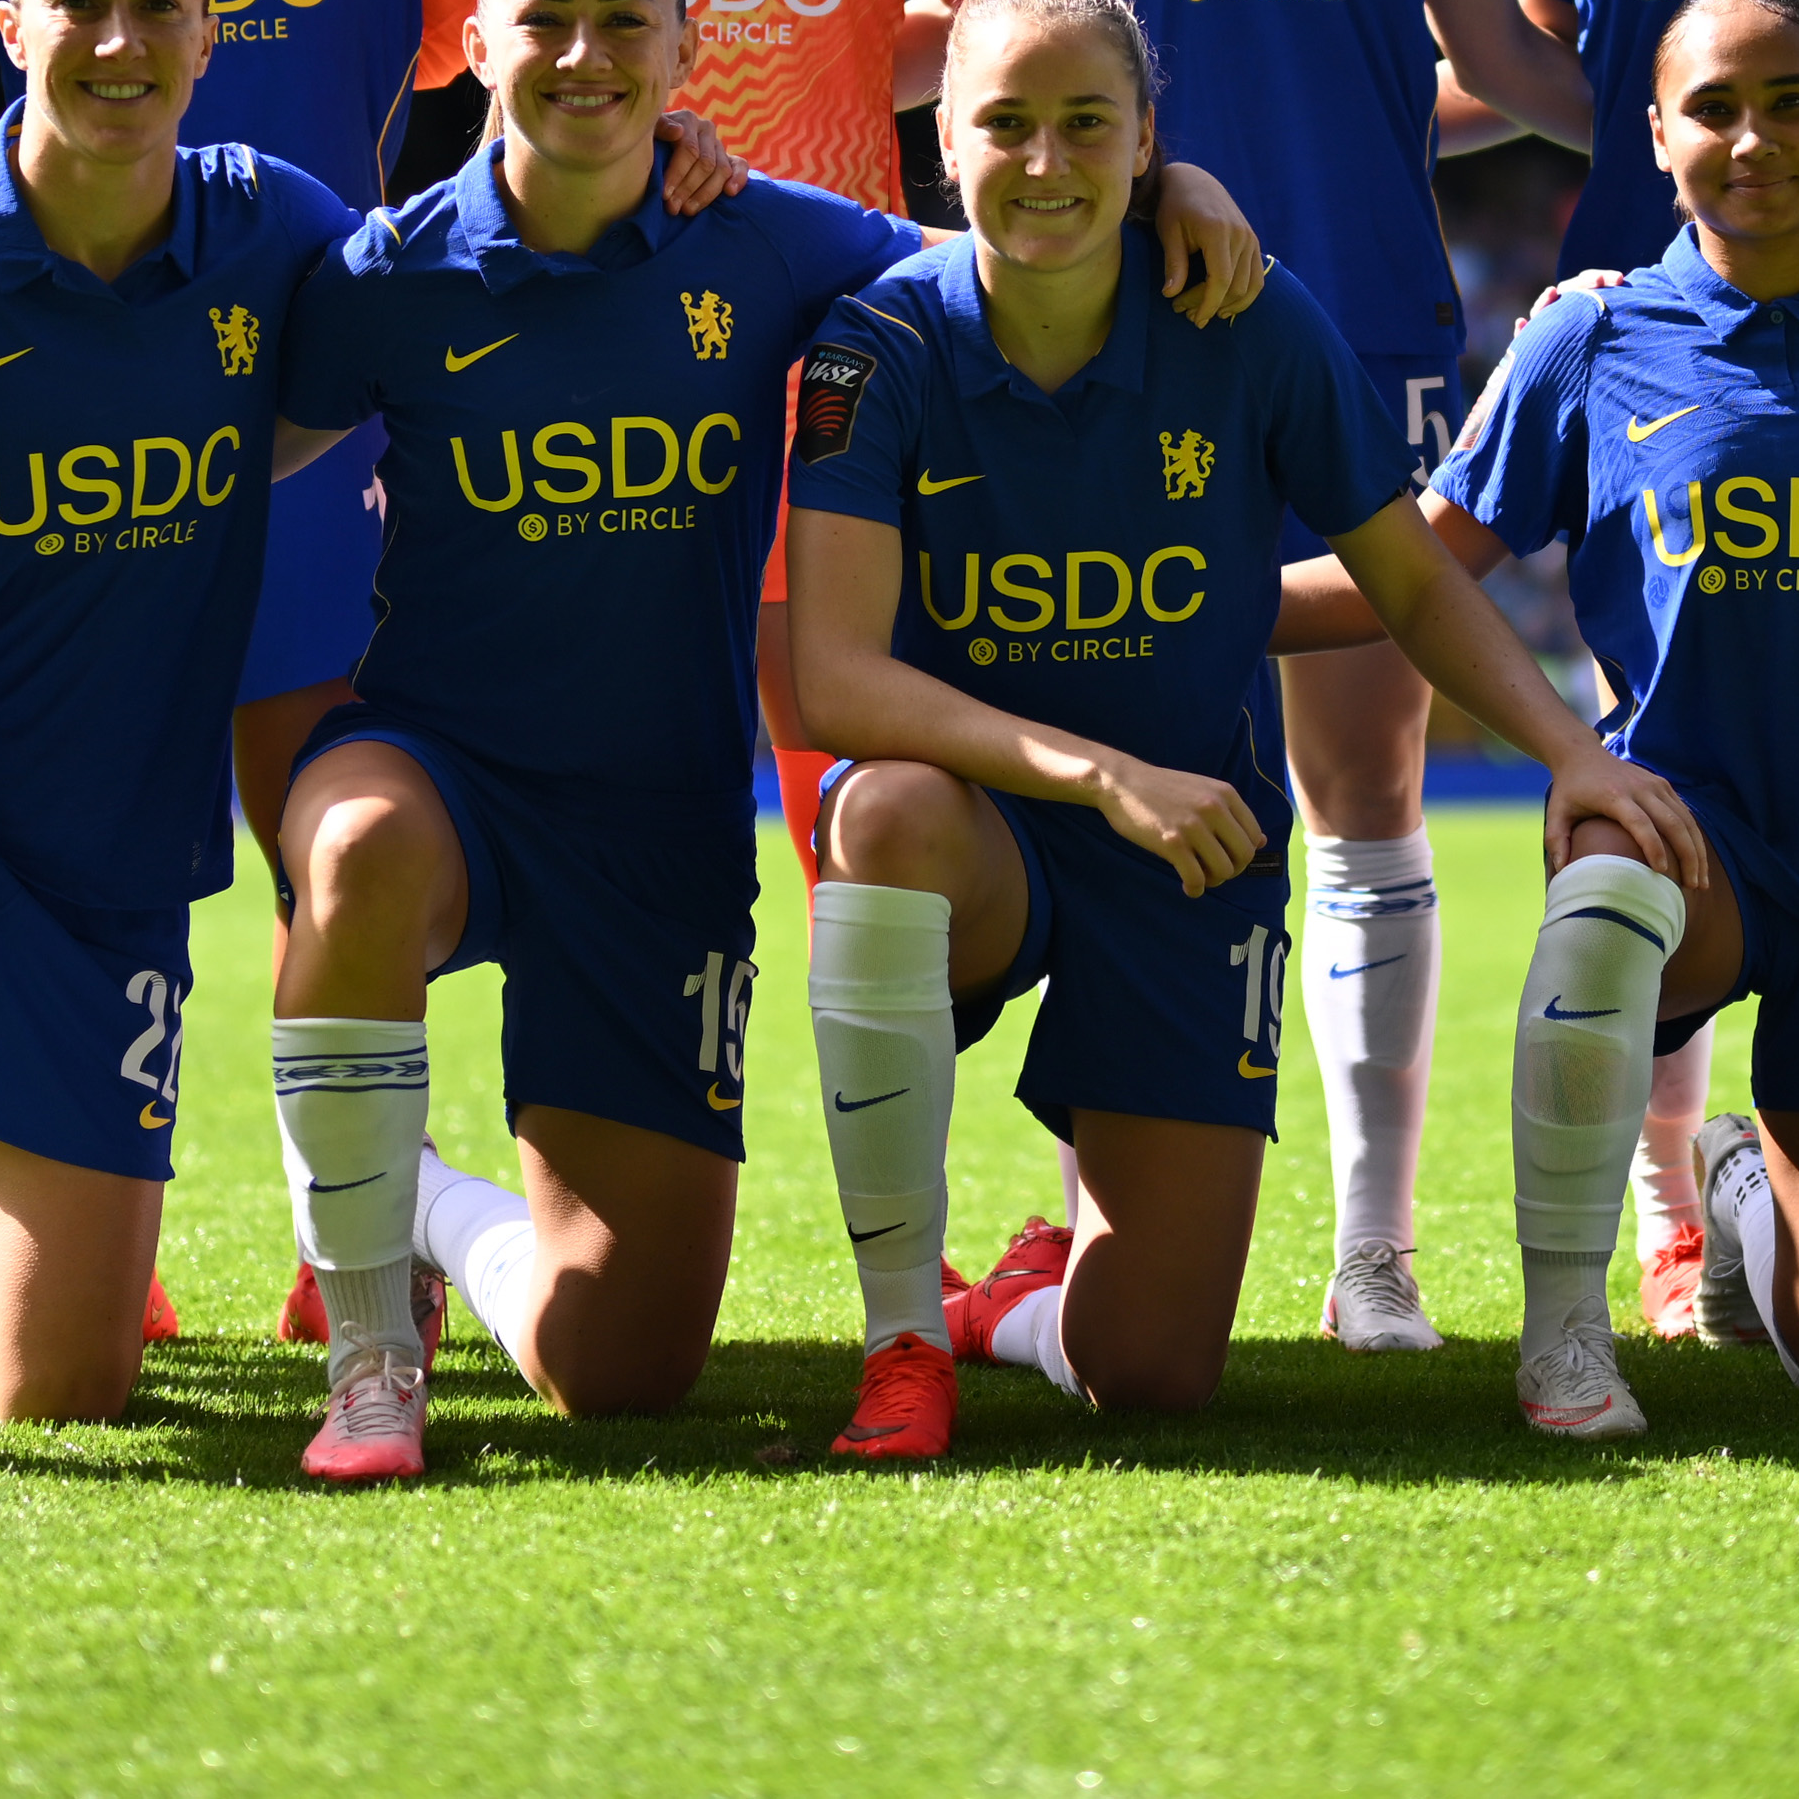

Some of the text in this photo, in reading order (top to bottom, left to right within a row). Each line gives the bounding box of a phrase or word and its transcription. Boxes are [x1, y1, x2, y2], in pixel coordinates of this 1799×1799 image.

[214, 17, 289, 44] IRCLE
[698, 20, 793, 46] CIRCLE
[825, 351, 867, 370] BARCLAYS
[803, 361, 862, 388] WSL
[450, 412, 741, 512] USDC
[557, 505, 695, 537] BY CIRCLE
[74, 519, 198, 554] BY CIRCLE
[919, 545, 1207, 633] USDC
[1734, 569, 1768, 590] BY
[1008, 635, 1154, 662] BY CIRCLE
